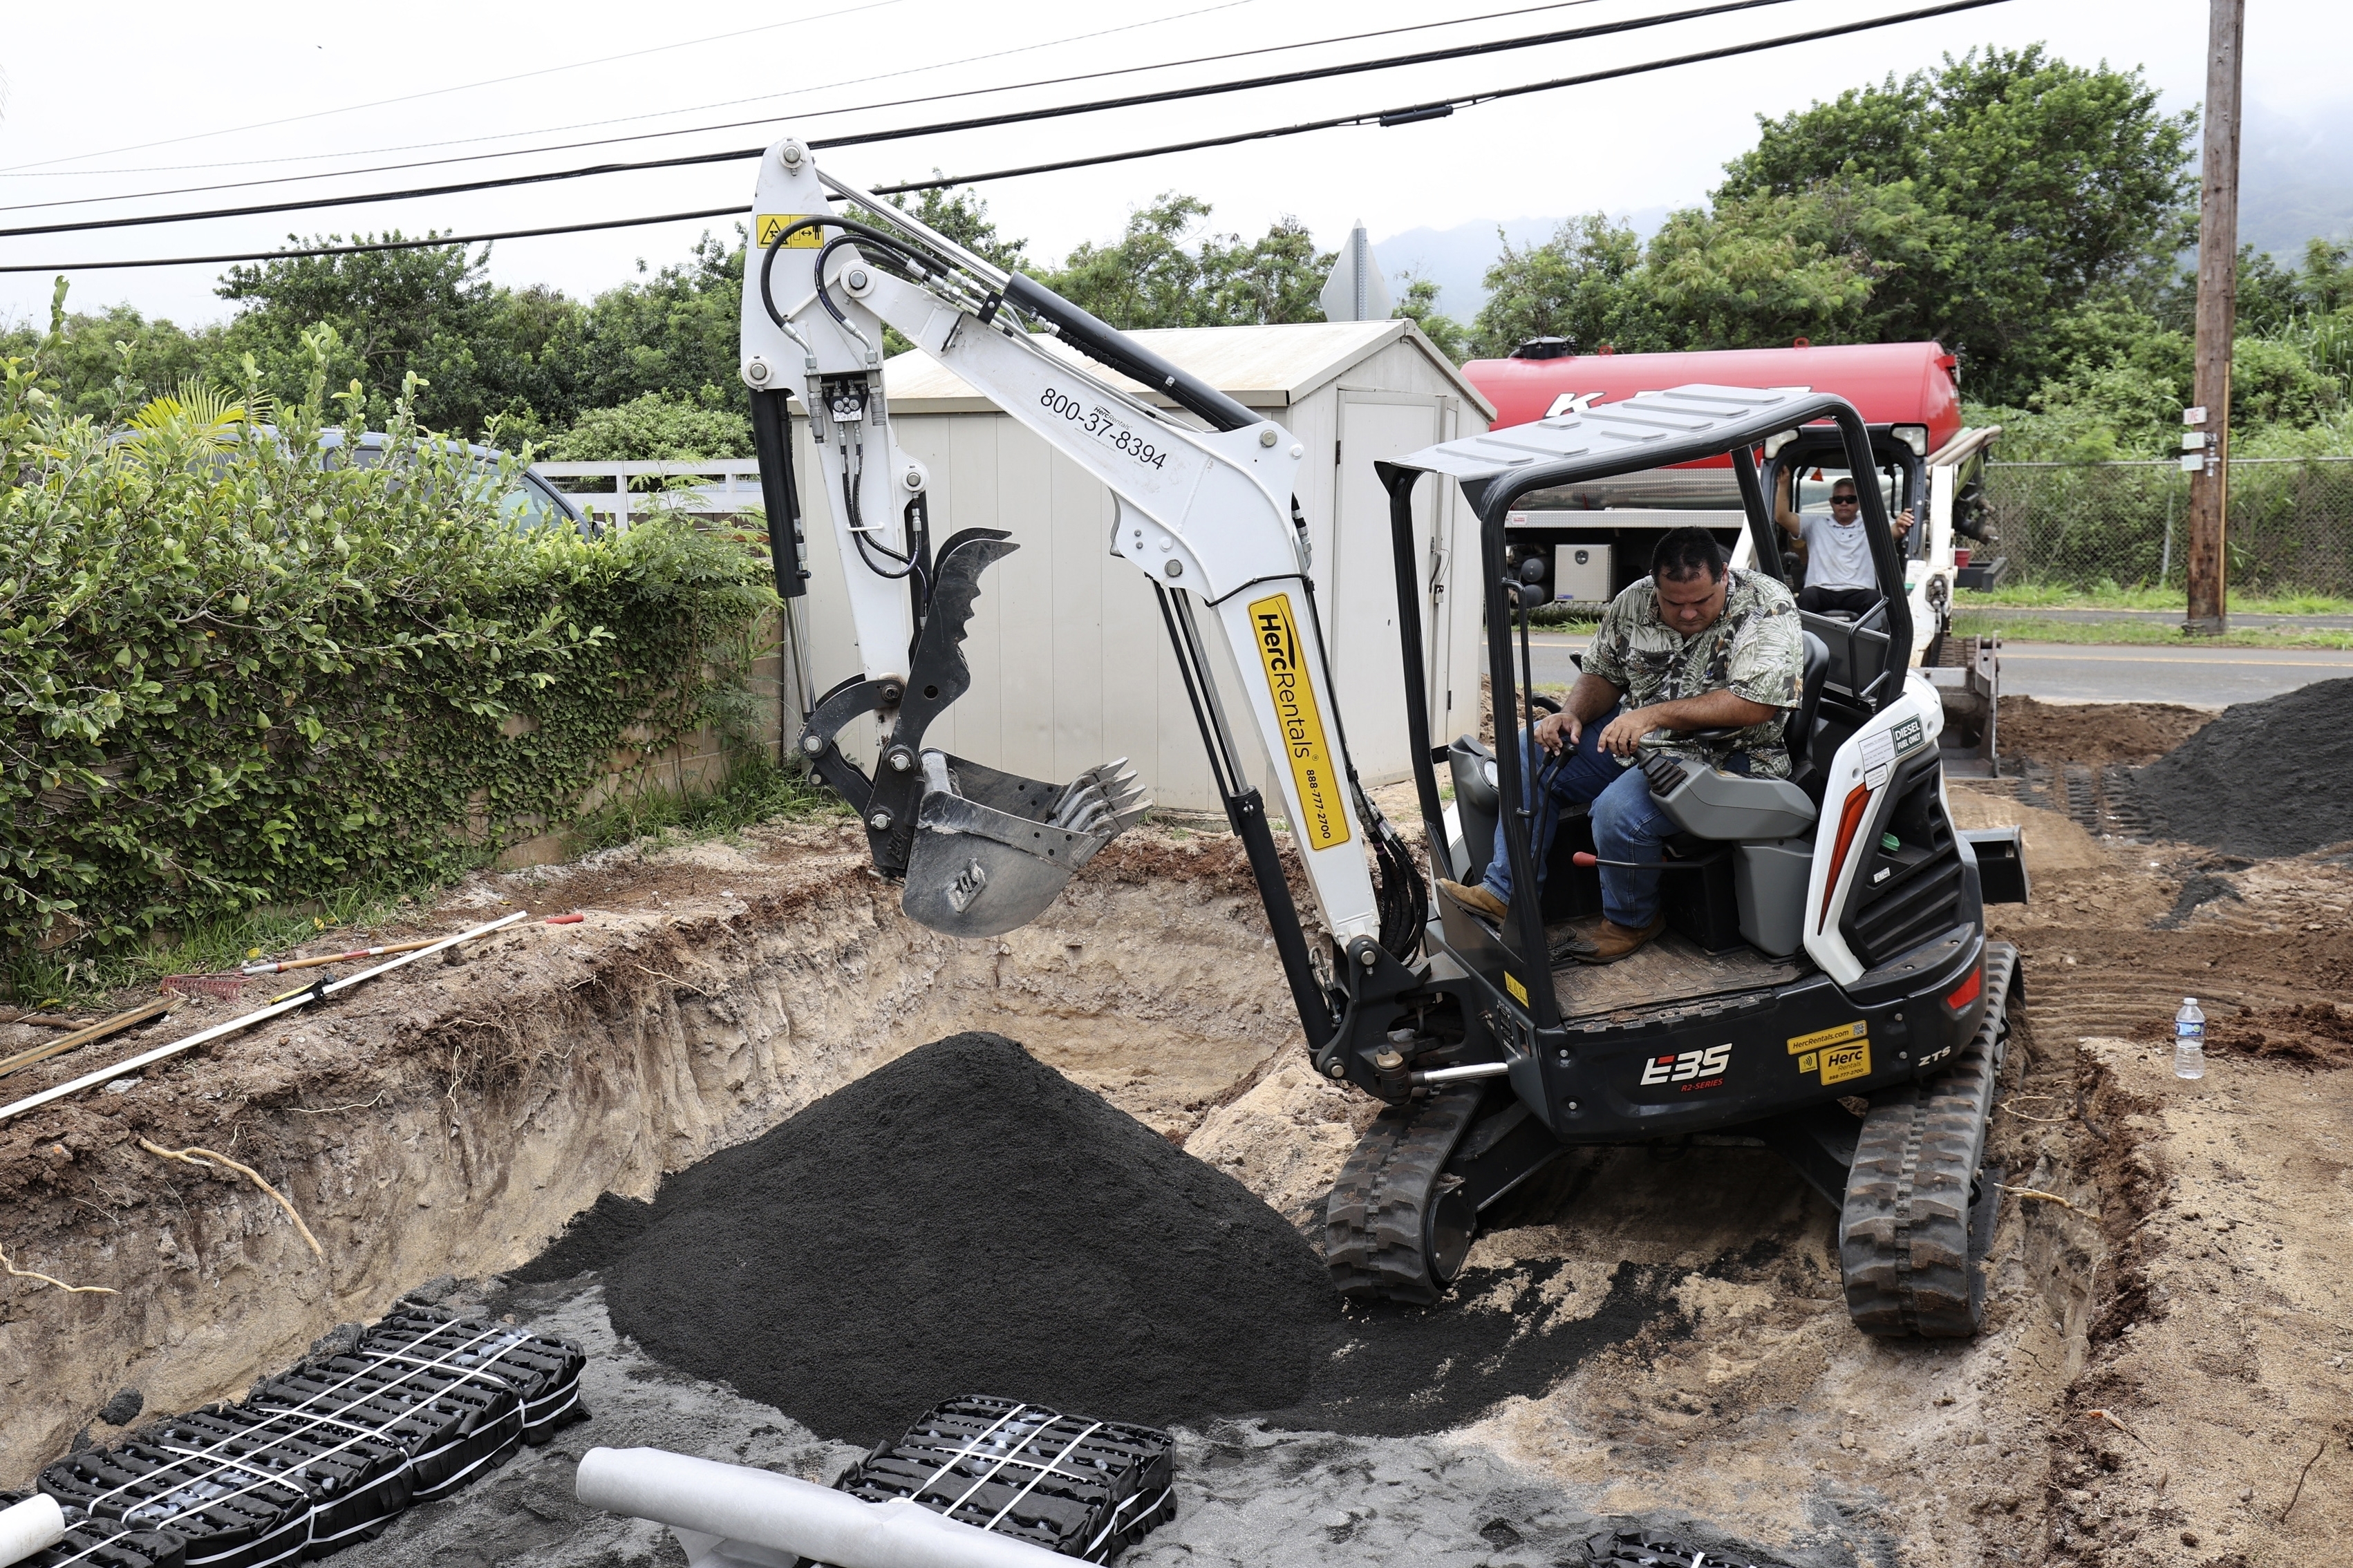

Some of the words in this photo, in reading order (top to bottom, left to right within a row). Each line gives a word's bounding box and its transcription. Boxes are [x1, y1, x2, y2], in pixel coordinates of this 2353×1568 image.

[1040, 388, 1167, 470] 800-37-8394
[1895, 721, 1920, 741] DIESEL
[1897, 739, 1909, 750] FUEL
[1909, 732, 1921, 744] ONLY
[1306, 769, 1331, 839] 888-777-2700
[1792, 1030, 1849, 1049] HercRentals.com
[1640, 1042, 1733, 1086] E35
[1828, 1050, 1864, 1067] Herc
[1918, 1046, 1951, 1067] ZTS
[1829, 1068, 1864, 1081] 888-777-2700
[1838, 1061, 1862, 1072] Rentals
[1681, 1078, 1723, 1092] R2-SERIES
